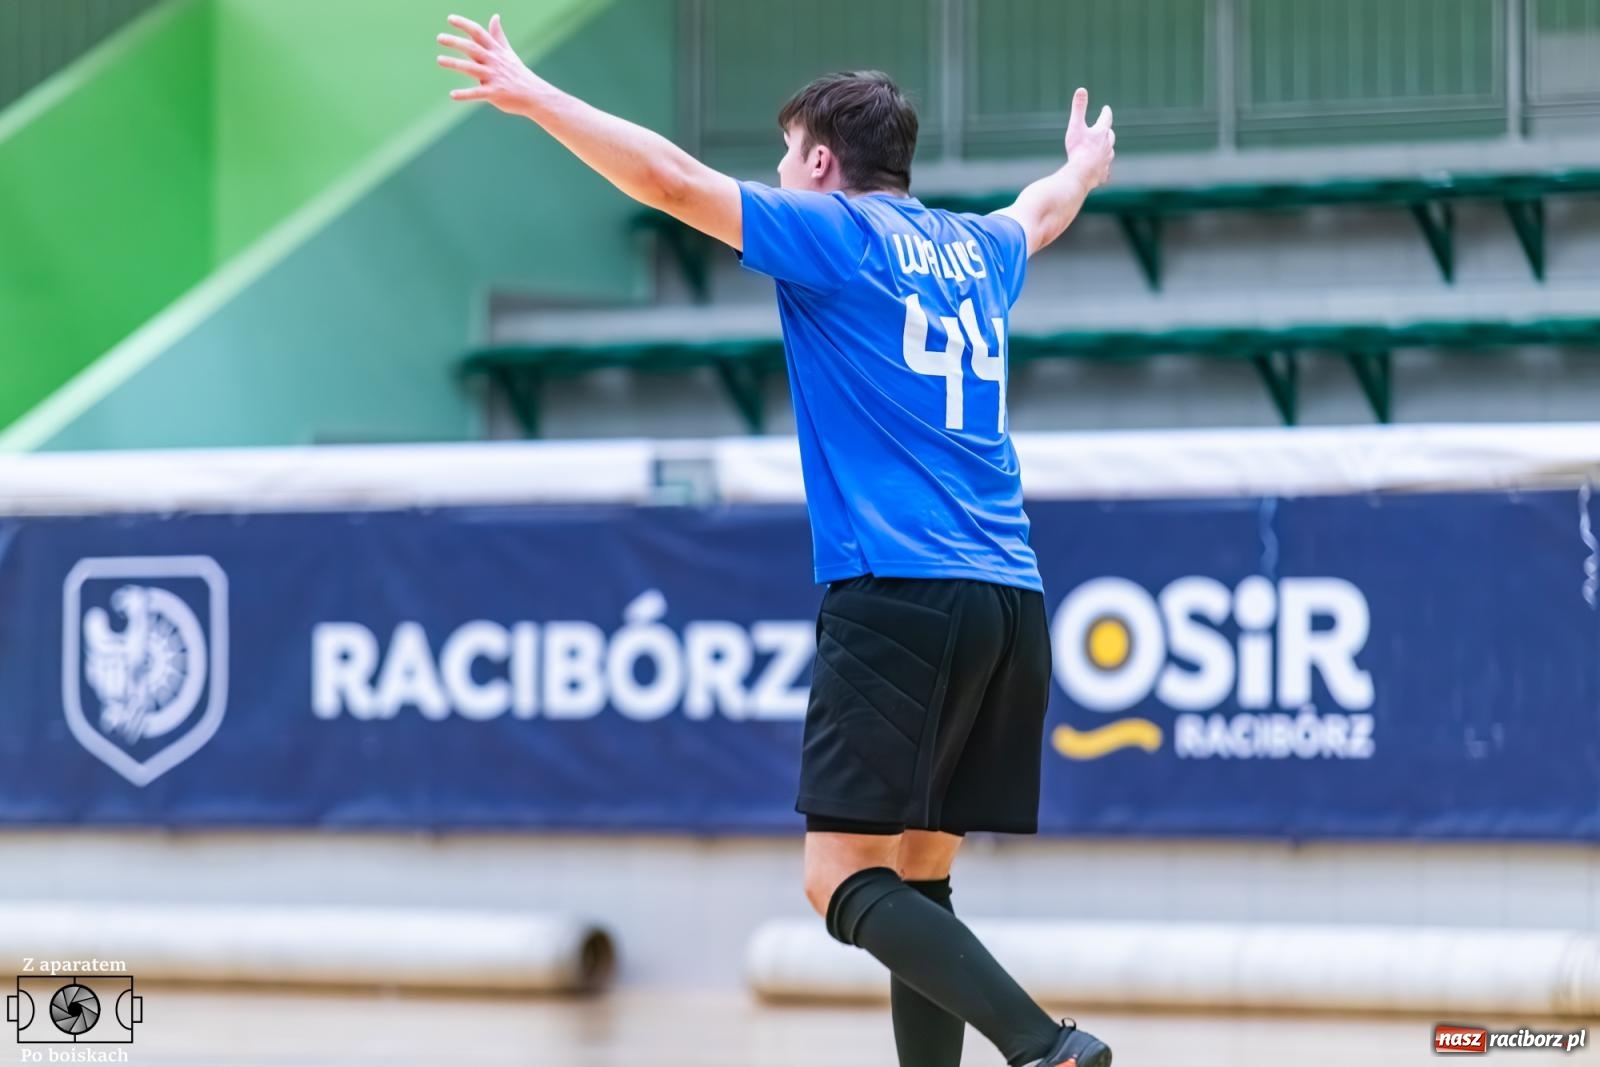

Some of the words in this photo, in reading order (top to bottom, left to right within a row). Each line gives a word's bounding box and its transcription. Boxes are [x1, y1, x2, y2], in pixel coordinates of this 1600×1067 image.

[903, 293, 1005, 434] 44
[311, 589, 818, 721] RACIBÓRZ
[1174, 704, 1375, 760] RACIBÓRZ
